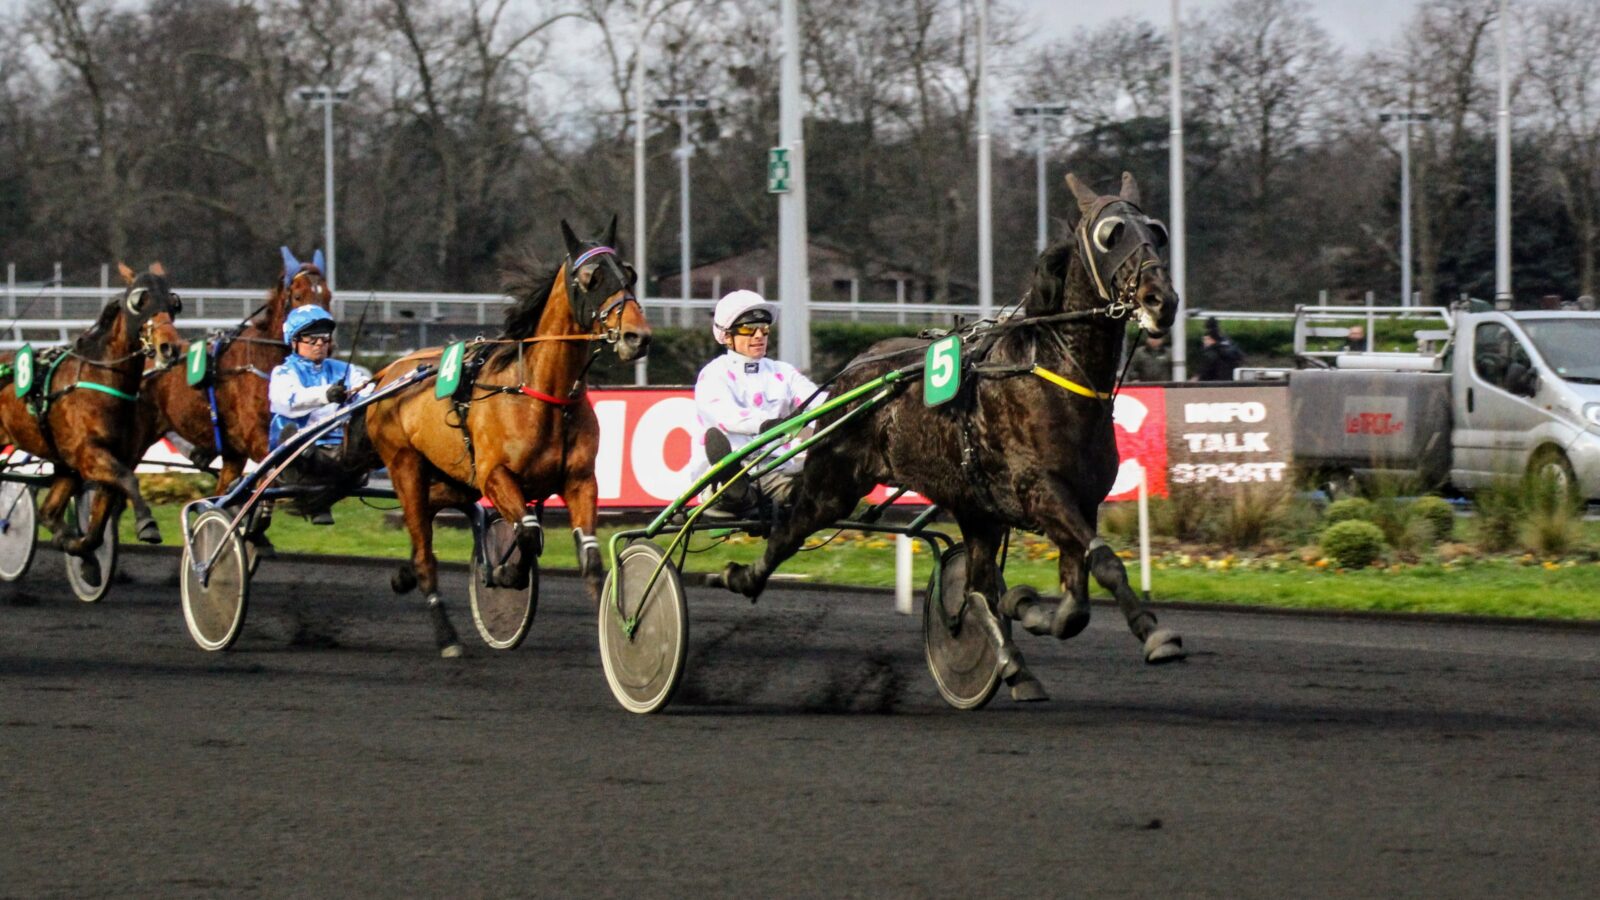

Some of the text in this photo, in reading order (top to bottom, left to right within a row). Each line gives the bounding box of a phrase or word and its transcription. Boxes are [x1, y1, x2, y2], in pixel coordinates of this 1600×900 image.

[16, 352, 31, 389] 8
[189, 340, 204, 374] 7
[439, 343, 460, 382] 4
[930, 338, 954, 388] 5
[1184, 401, 1267, 423] INFO
[1182, 432, 1271, 453] TALK
[1170, 461, 1287, 484] SPORT
